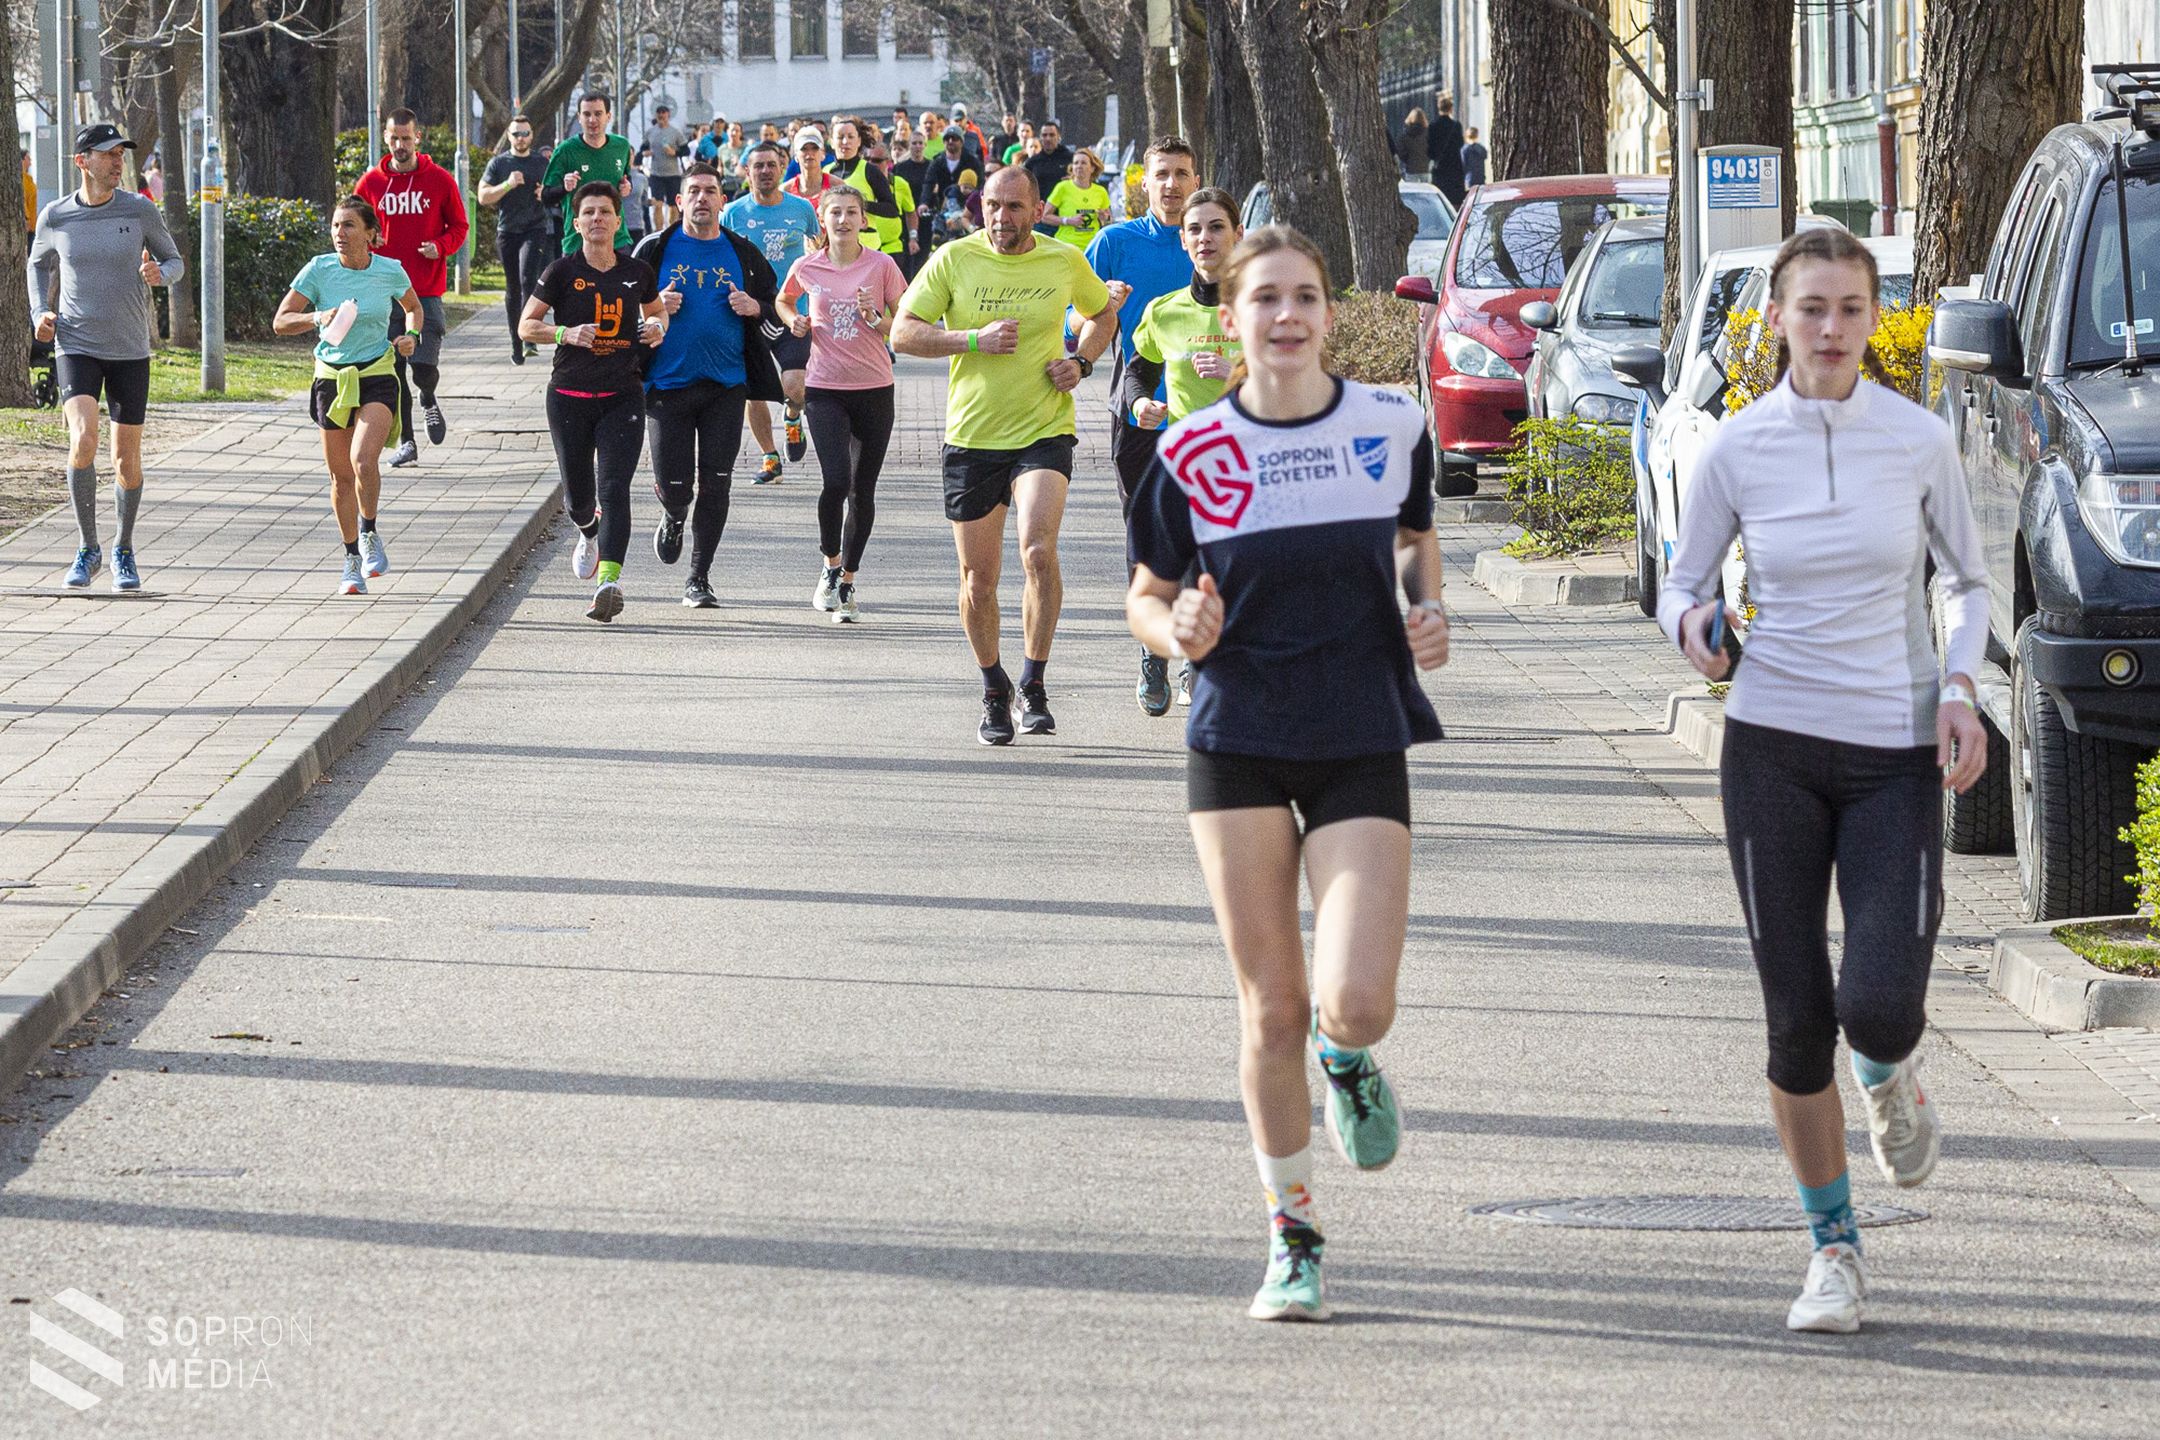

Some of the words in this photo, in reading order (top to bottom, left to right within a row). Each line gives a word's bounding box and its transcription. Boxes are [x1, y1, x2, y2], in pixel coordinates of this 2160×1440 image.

[1711, 158, 1758, 179] 9403
[834, 316, 855, 329] EGY
[833, 327, 859, 341] KÖR
[1257, 446, 1334, 468] SOPRONI
[1259, 464, 1337, 487] EGYETEM
